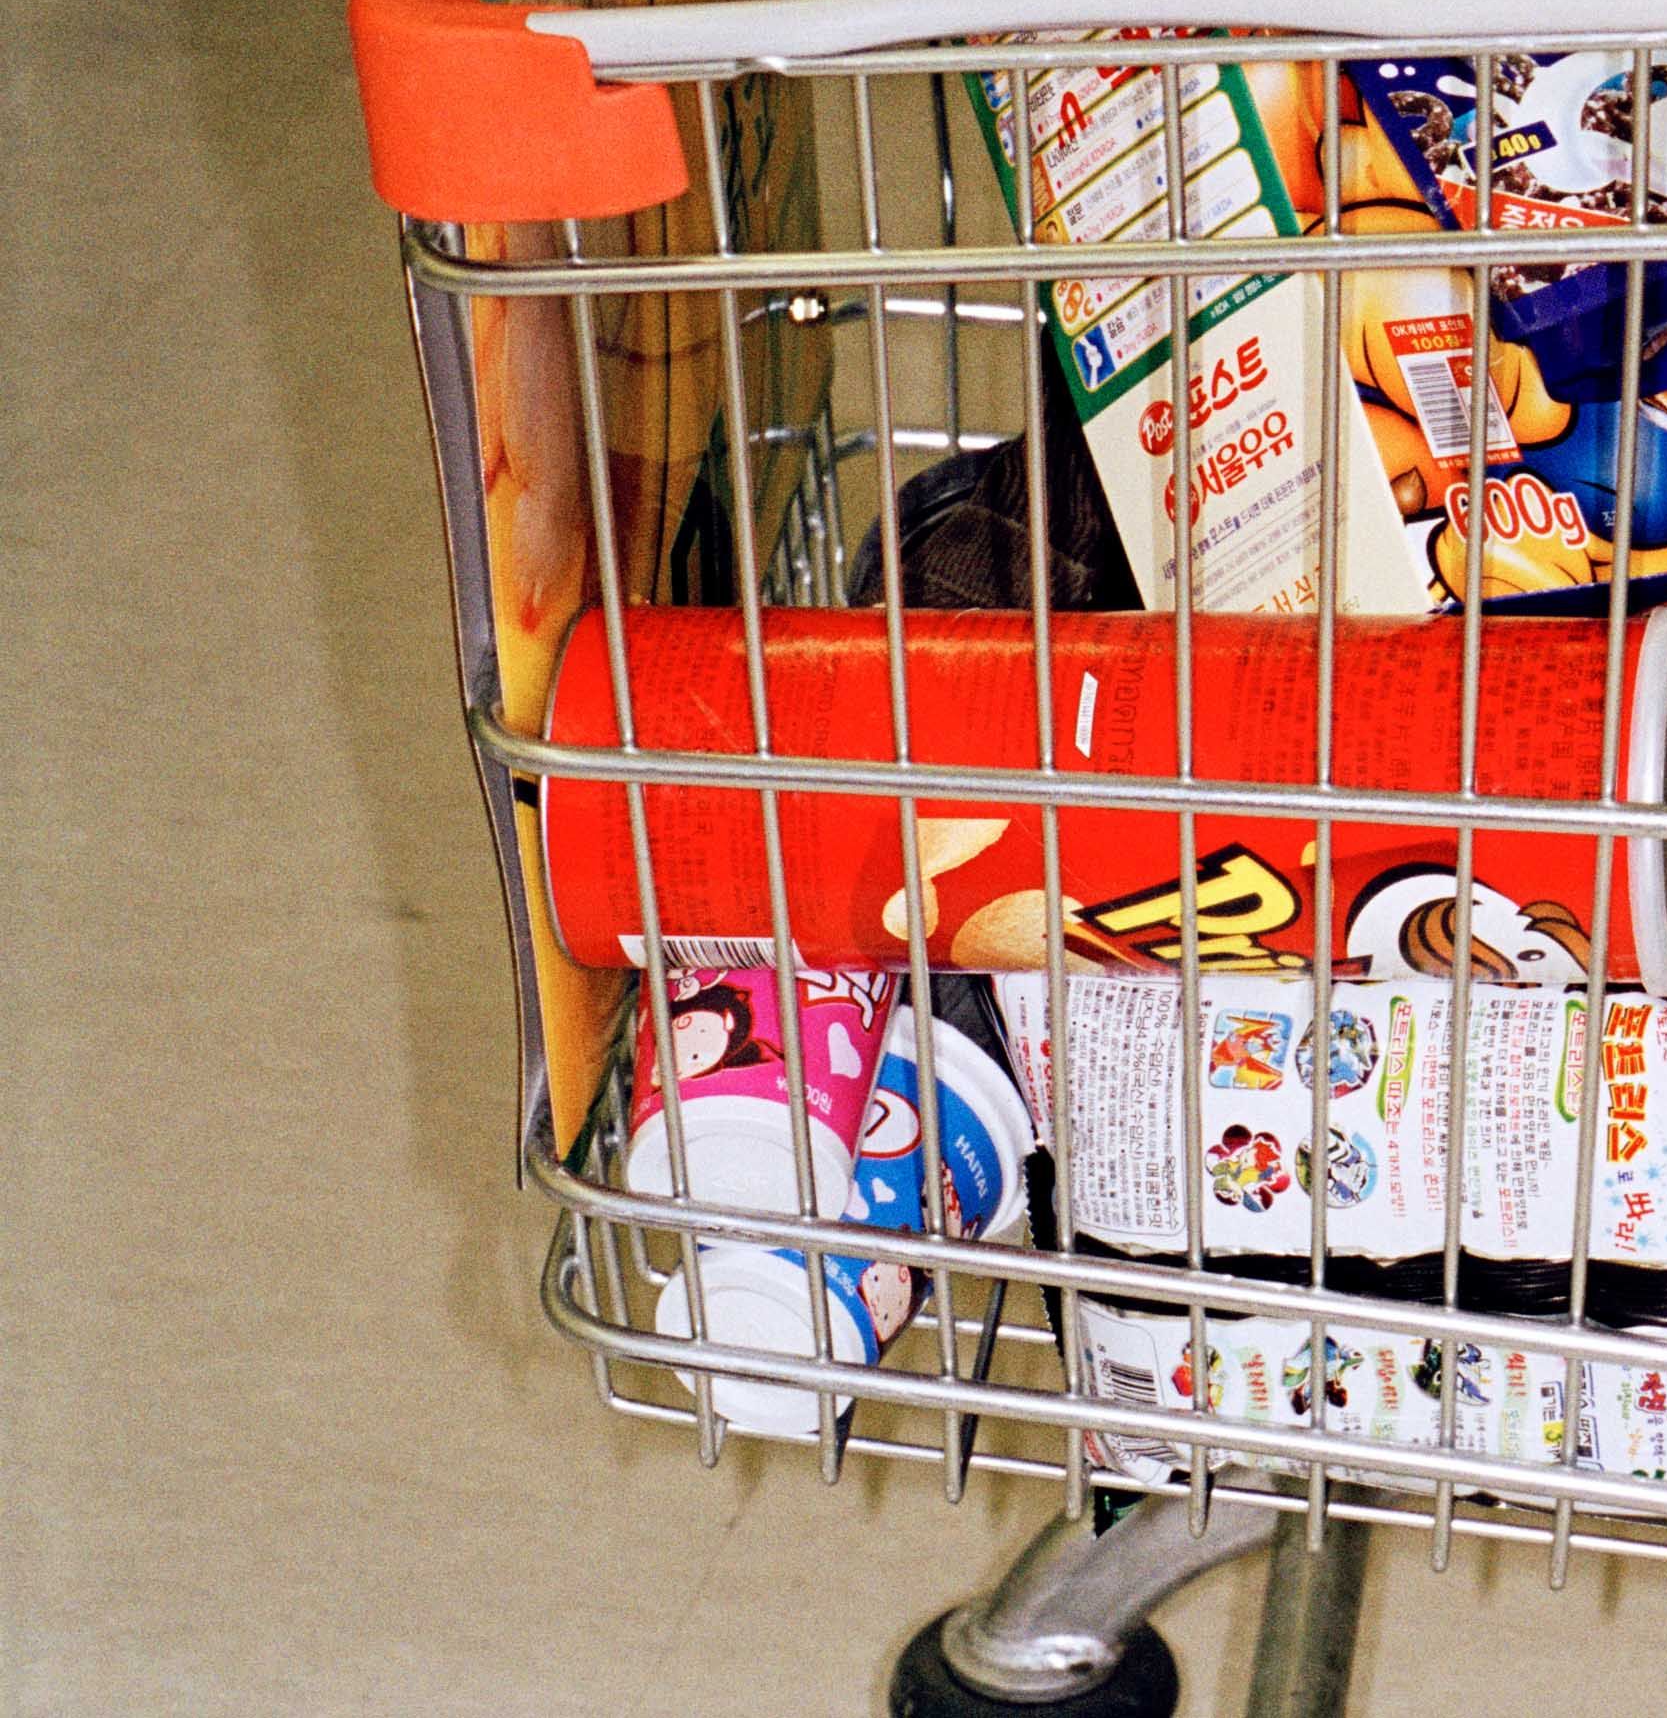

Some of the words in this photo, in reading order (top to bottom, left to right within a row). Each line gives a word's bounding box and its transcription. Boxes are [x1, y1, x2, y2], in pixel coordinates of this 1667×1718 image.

[1173, 335, 1282, 428] 포스트
[1136, 404, 1178, 442] Post
[1180, 408, 1305, 505] 서울우유
[1444, 471, 1589, 550] 600g
[1154, 989, 1173, 1029] 100%
[1524, 999, 1540, 1057] 포트리스를
[1389, 1001, 1412, 1076] 포트리스
[1537, 1025, 1553, 1063] 최고의
[1522, 1061, 1536, 1090] SBS
[1536, 1066, 1550, 1092] 인기
[1596, 1001, 1654, 1163] 포트리스
[1385, 1080, 1403, 1135] 따조는
[1479, 1097, 1493, 1120] 강한
[1519, 1094, 1536, 1154] 만화영화로
[1535, 1097, 1551, 1134] 온라인
[1479, 1125, 1493, 1149] 의지
[1493, 1121, 1510, 1159] 모으고
[954, 1133, 988, 1199] HAITAI
[1385, 1140, 1403, 1177] 4가지
[1508, 1149, 1521, 1172] 의해
[1616, 1169, 1634, 1185] 로
[1508, 1176, 1529, 1229] 만화영화로
